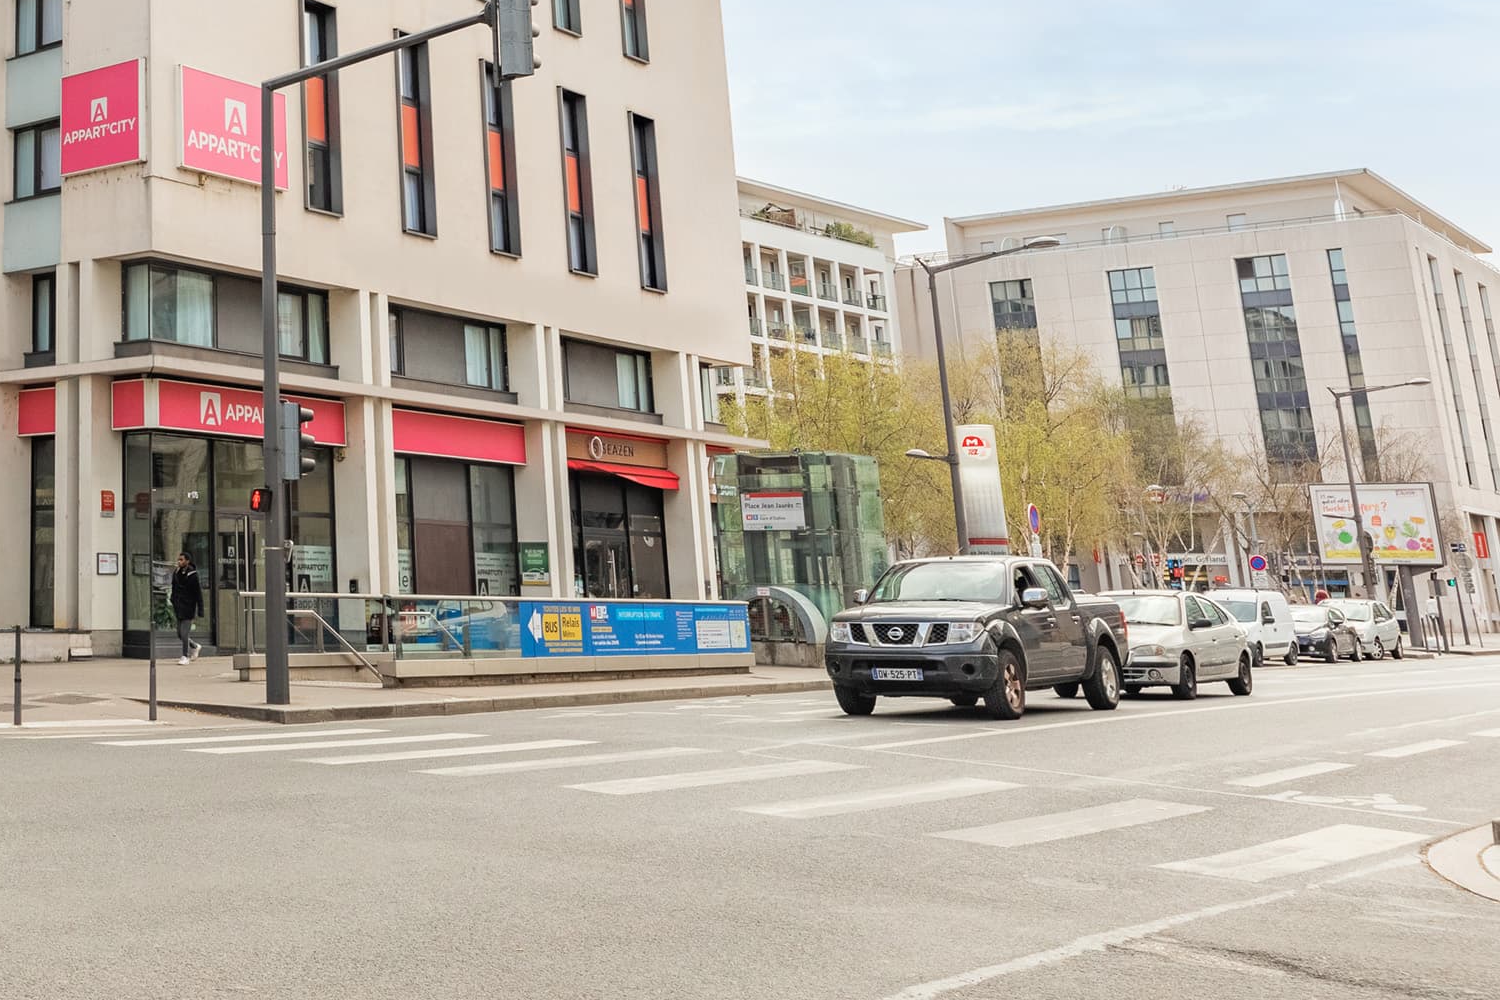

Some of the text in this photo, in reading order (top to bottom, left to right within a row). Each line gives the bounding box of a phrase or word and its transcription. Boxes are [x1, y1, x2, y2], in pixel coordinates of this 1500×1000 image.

[63, 117, 137, 145] APPART'CITY
[187, 129, 284, 169] APPART'CY
[544, 617, 580, 633] BUS Relais
